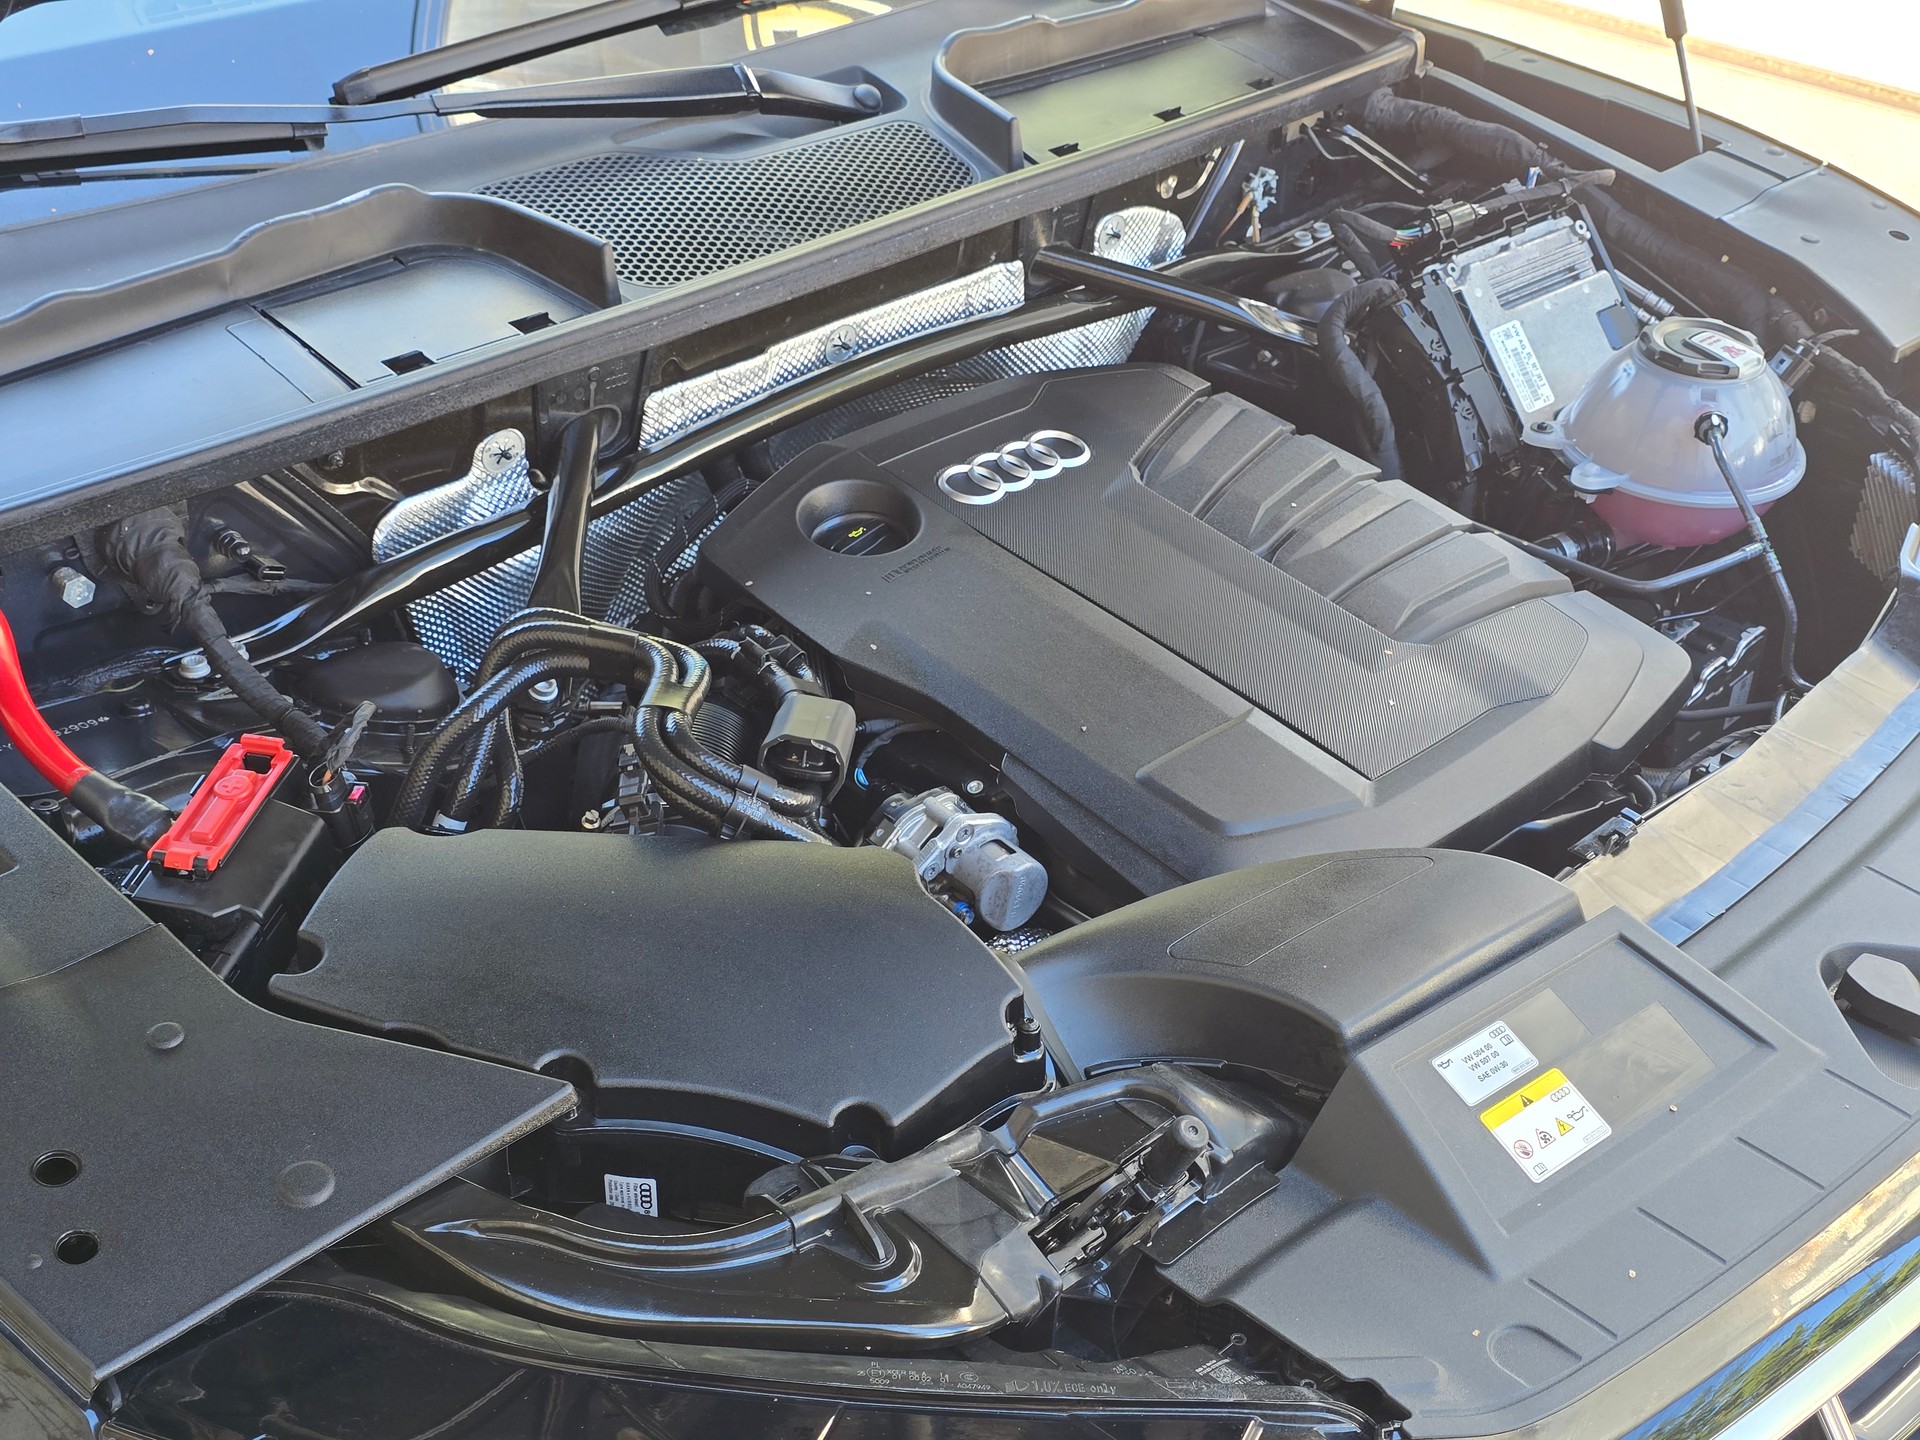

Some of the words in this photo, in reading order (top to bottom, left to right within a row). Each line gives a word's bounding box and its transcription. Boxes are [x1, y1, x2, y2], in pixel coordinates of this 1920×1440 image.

[1511, 323, 1521, 337] VW
[1461, 1054, 1474, 1064] VW
[1472, 1047, 1485, 1058] 504
[1483, 1043, 1493, 1051] 00
[1467, 1061, 1481, 1072] VW
[1479, 1055, 1491, 1066] 507
[1490, 1050, 1500, 1059] 00
[1477, 1070, 1492, 1082] SAE
[1489, 1060, 1509, 1075] 0W-30
[1031, 1379, 1063, 1394] 1.0%
[1064, 1383, 1086, 1393] ECE
